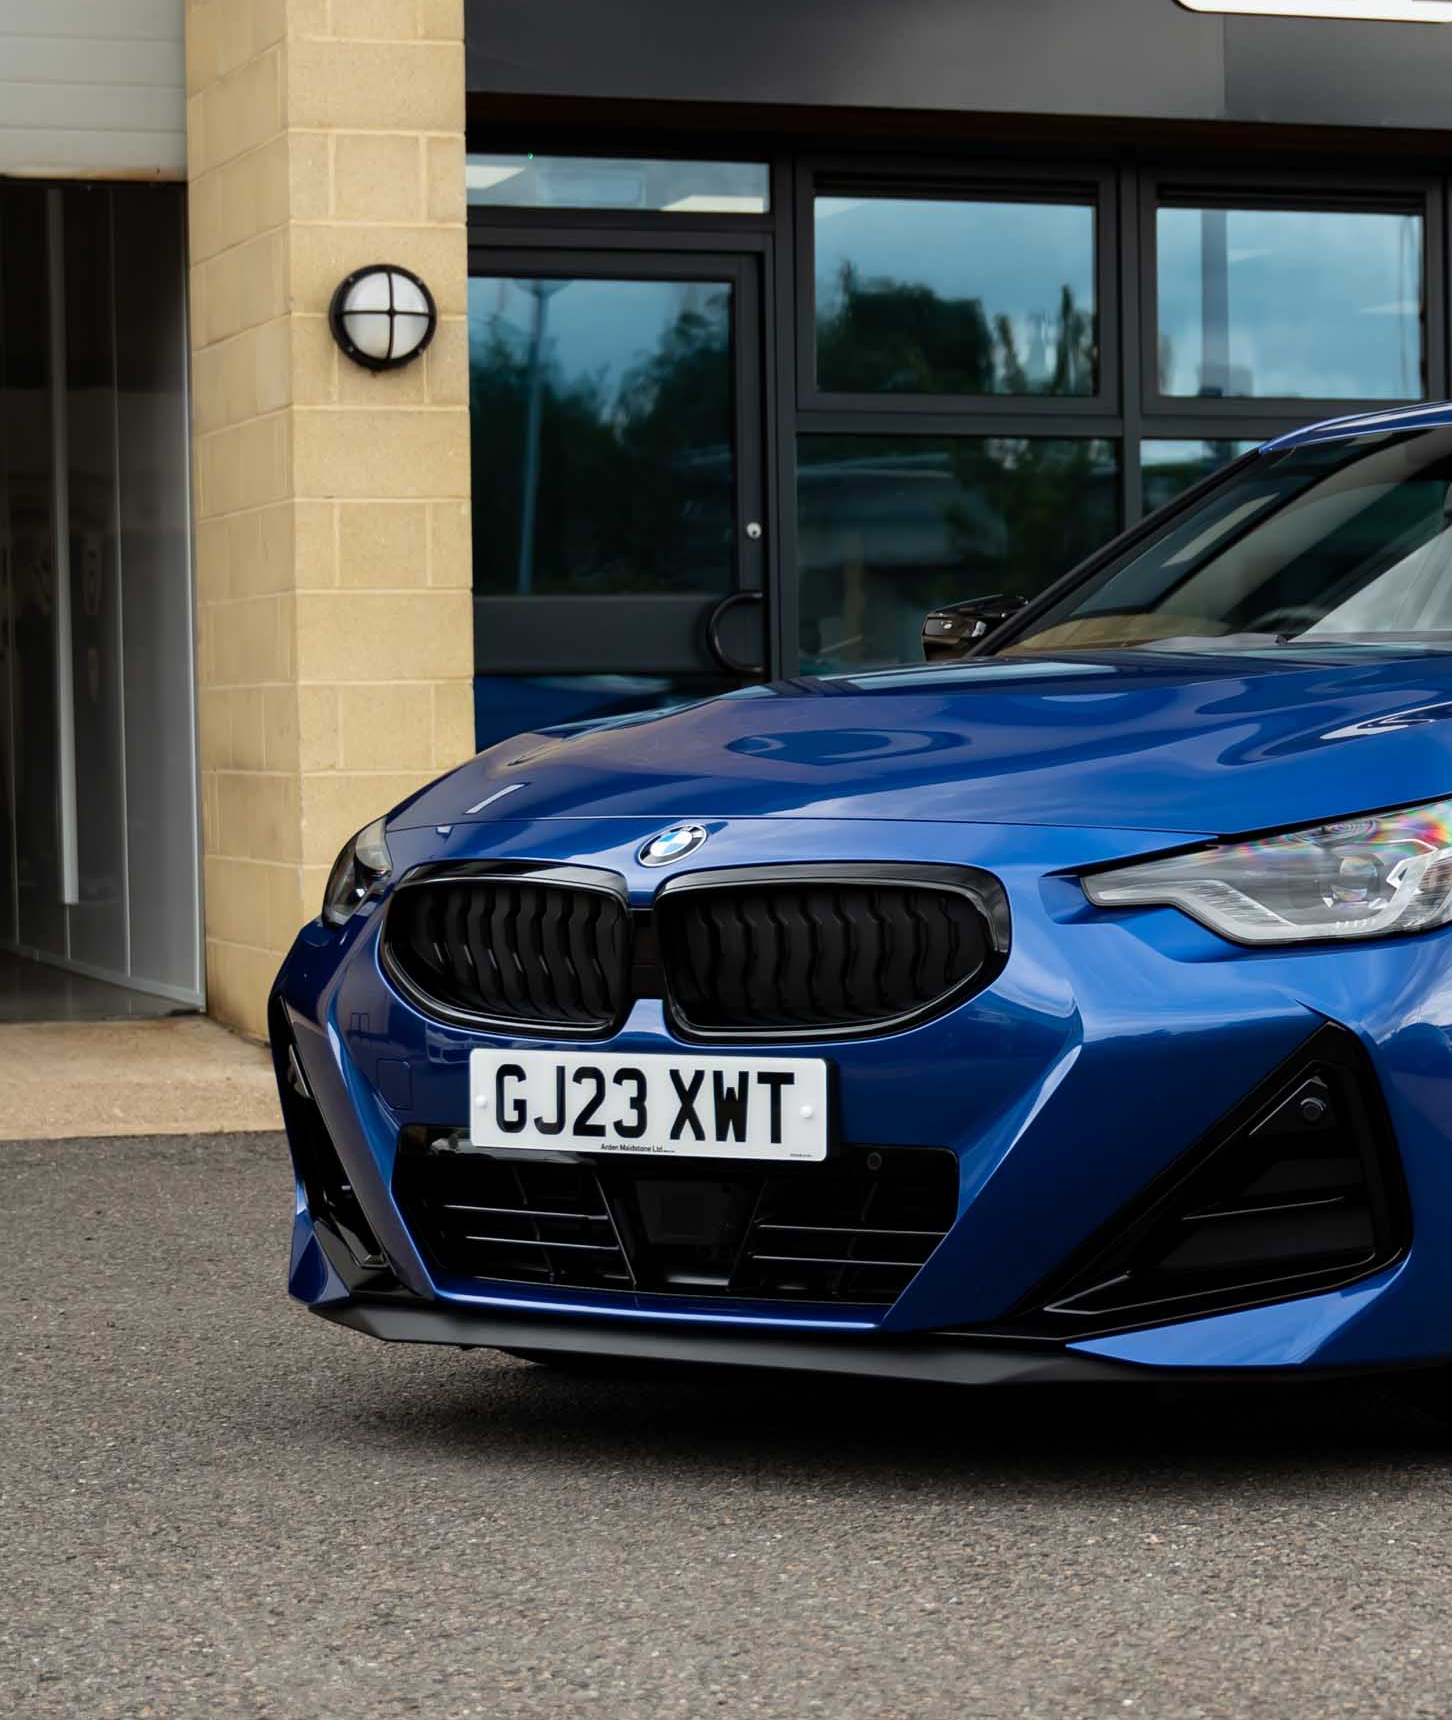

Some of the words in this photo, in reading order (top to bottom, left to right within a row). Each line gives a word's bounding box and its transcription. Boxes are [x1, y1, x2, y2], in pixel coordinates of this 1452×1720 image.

[495, 1063, 648, 1139] GJ23
[669, 1068, 796, 1144] XWT
[600, 1143, 618, 1151] Arden
[620, 1143, 651, 1152] Maidstone
